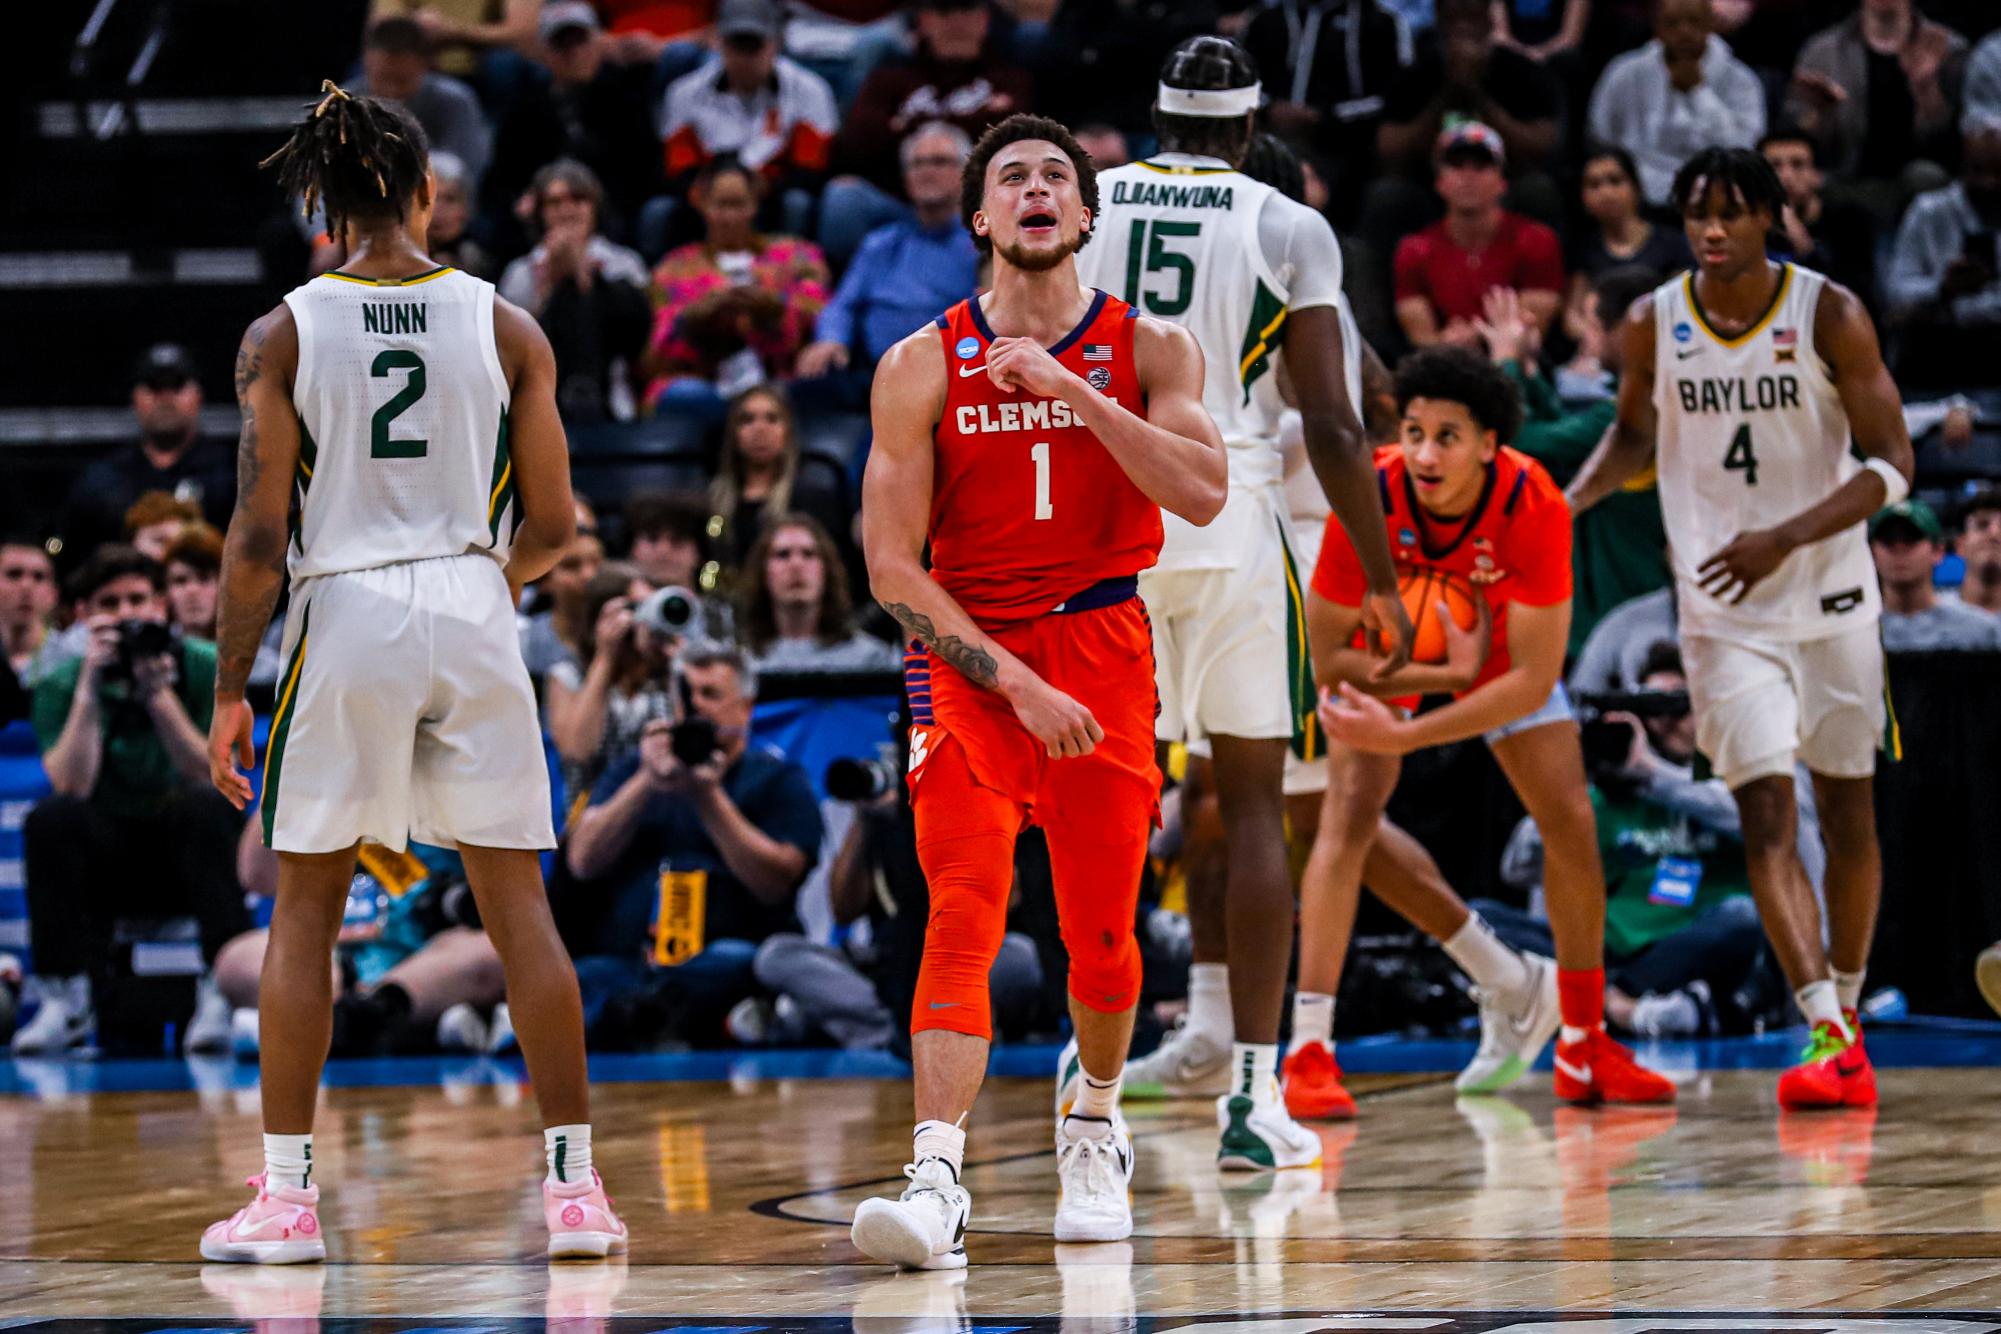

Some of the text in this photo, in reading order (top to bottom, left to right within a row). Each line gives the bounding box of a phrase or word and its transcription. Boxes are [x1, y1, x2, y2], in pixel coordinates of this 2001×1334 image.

[1125, 218, 1202, 316] 15
[362, 303, 427, 334] NUNN
[371, 350, 428, 458] 2
[956, 397, 1118, 435] CLEMS
[1677, 374, 1800, 414] BAYLOR
[1031, 443, 1053, 520] 1
[1722, 421, 1758, 486] 4
